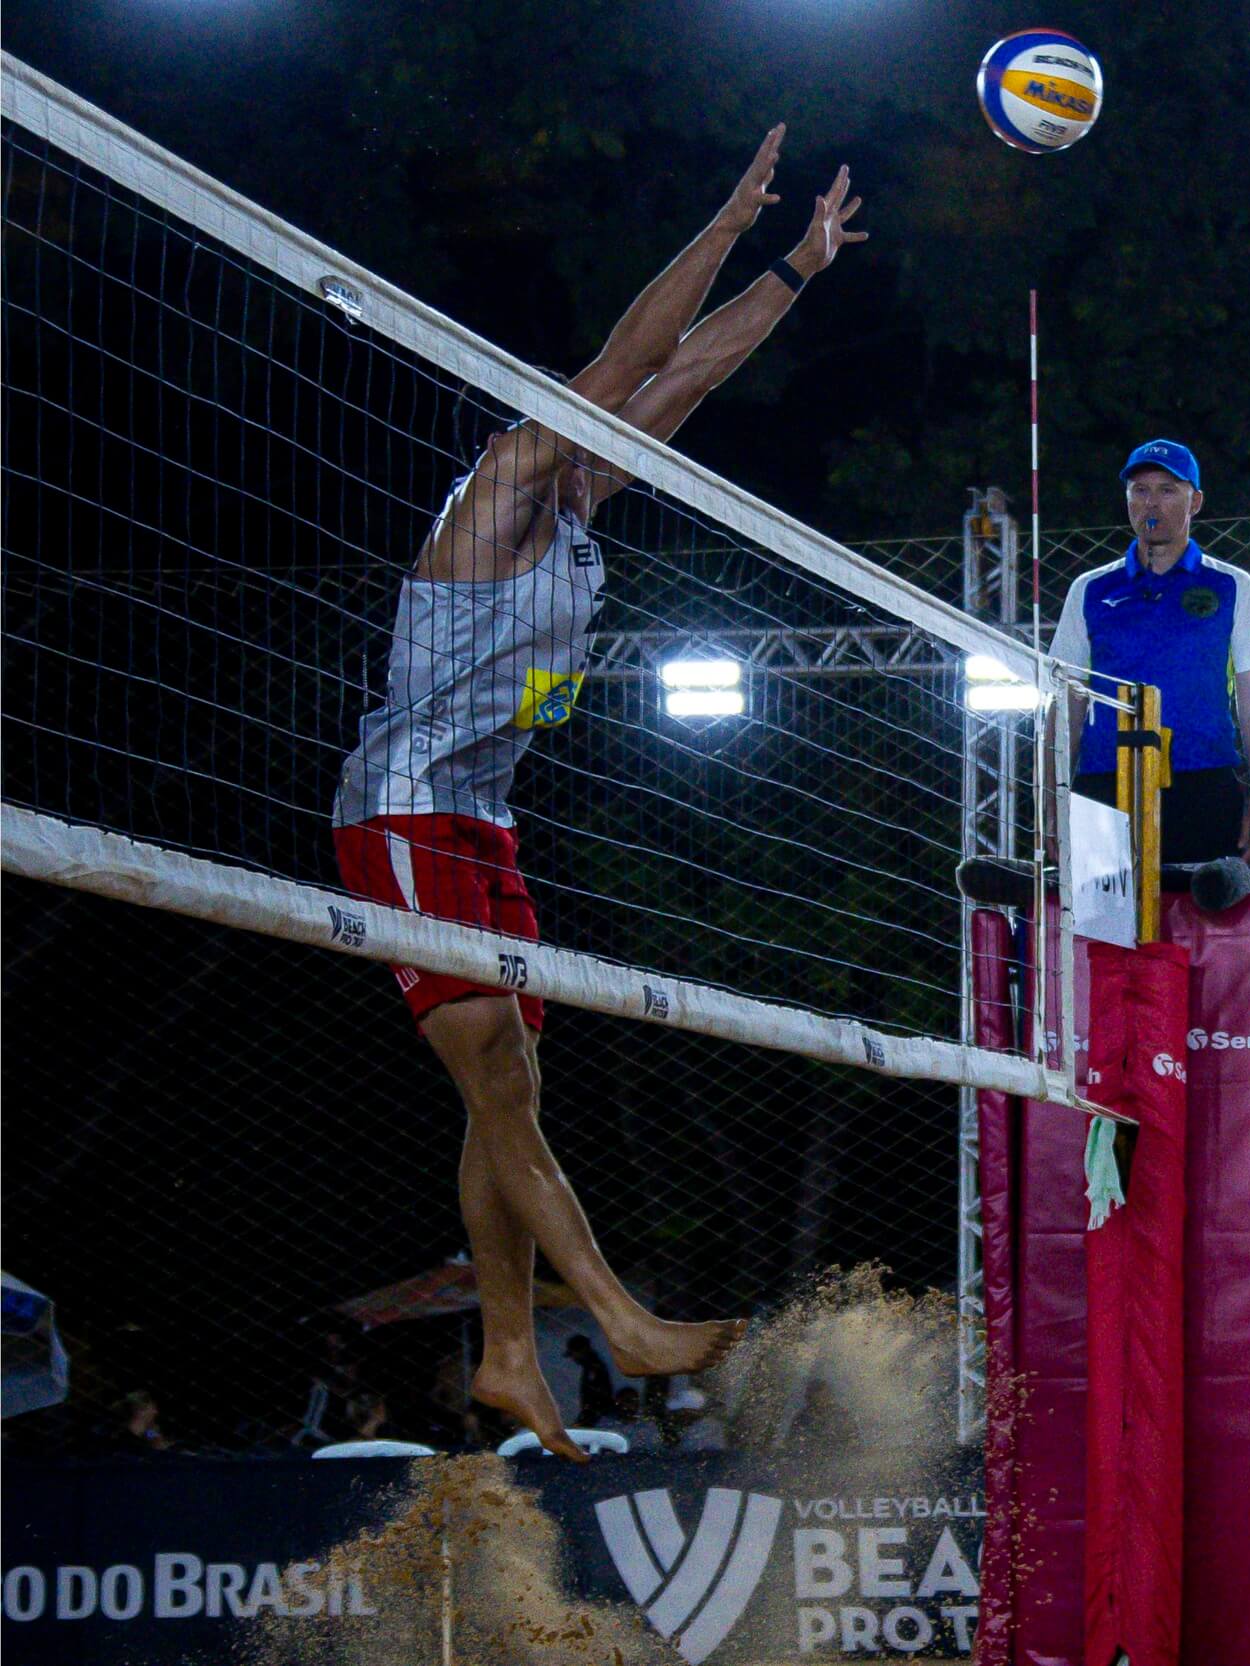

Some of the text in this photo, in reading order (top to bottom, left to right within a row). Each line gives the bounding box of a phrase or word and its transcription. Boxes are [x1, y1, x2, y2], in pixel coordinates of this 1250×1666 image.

[795, 1497, 989, 1519] VOLLEYBALL
[0, 1552, 378, 1622] O DO BRASIL
[794, 1526, 984, 1599] BEA
[797, 1606, 933, 1652] PRO
